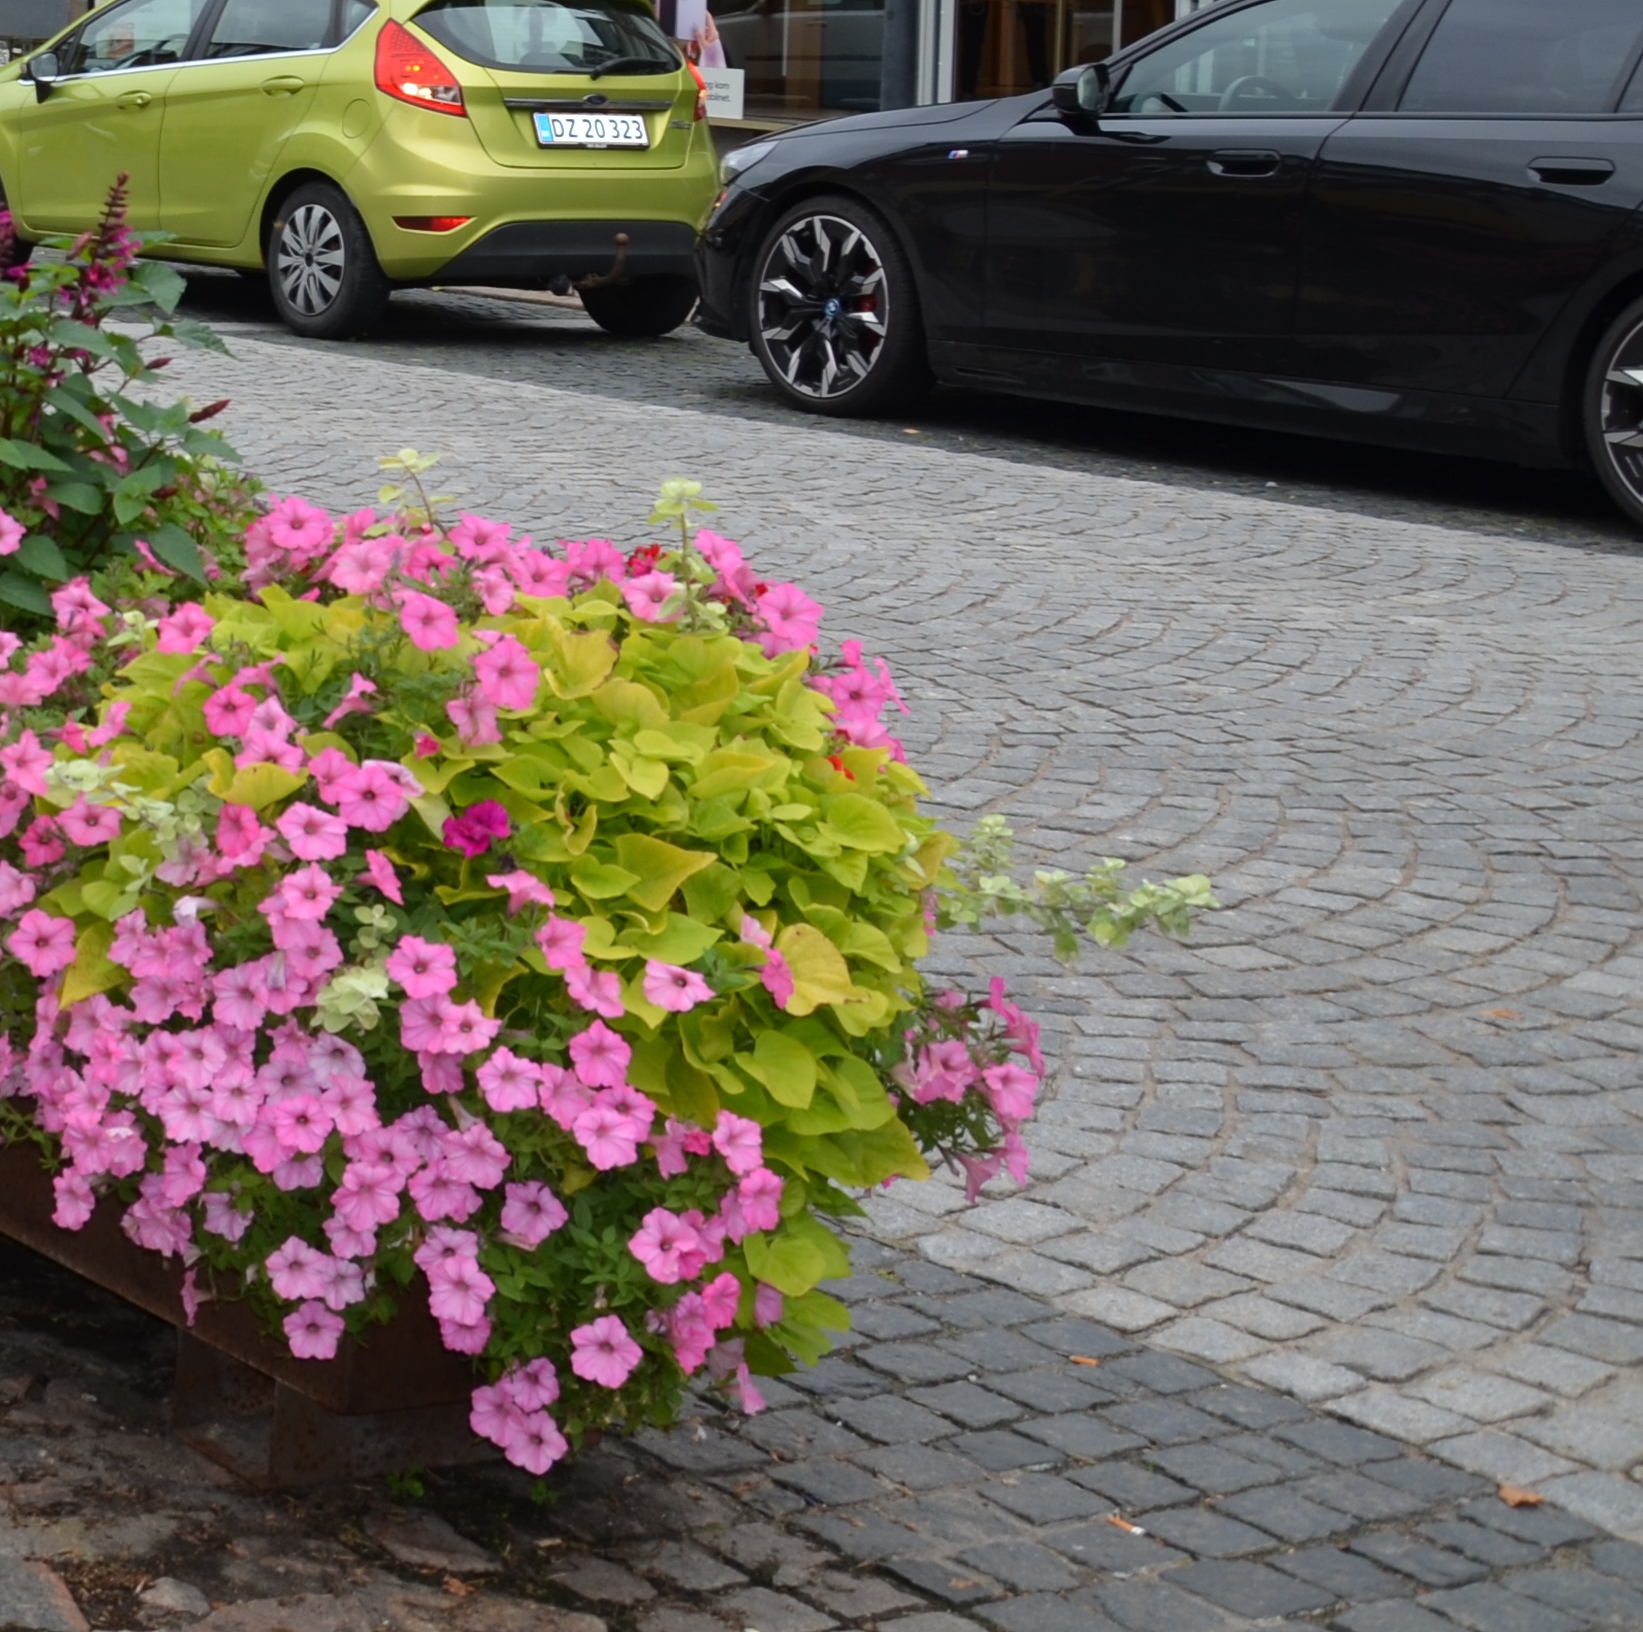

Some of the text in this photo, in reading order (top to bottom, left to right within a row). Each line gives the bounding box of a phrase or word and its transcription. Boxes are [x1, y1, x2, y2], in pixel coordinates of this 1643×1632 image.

[551, 119, 643, 140] DZ 20 323
